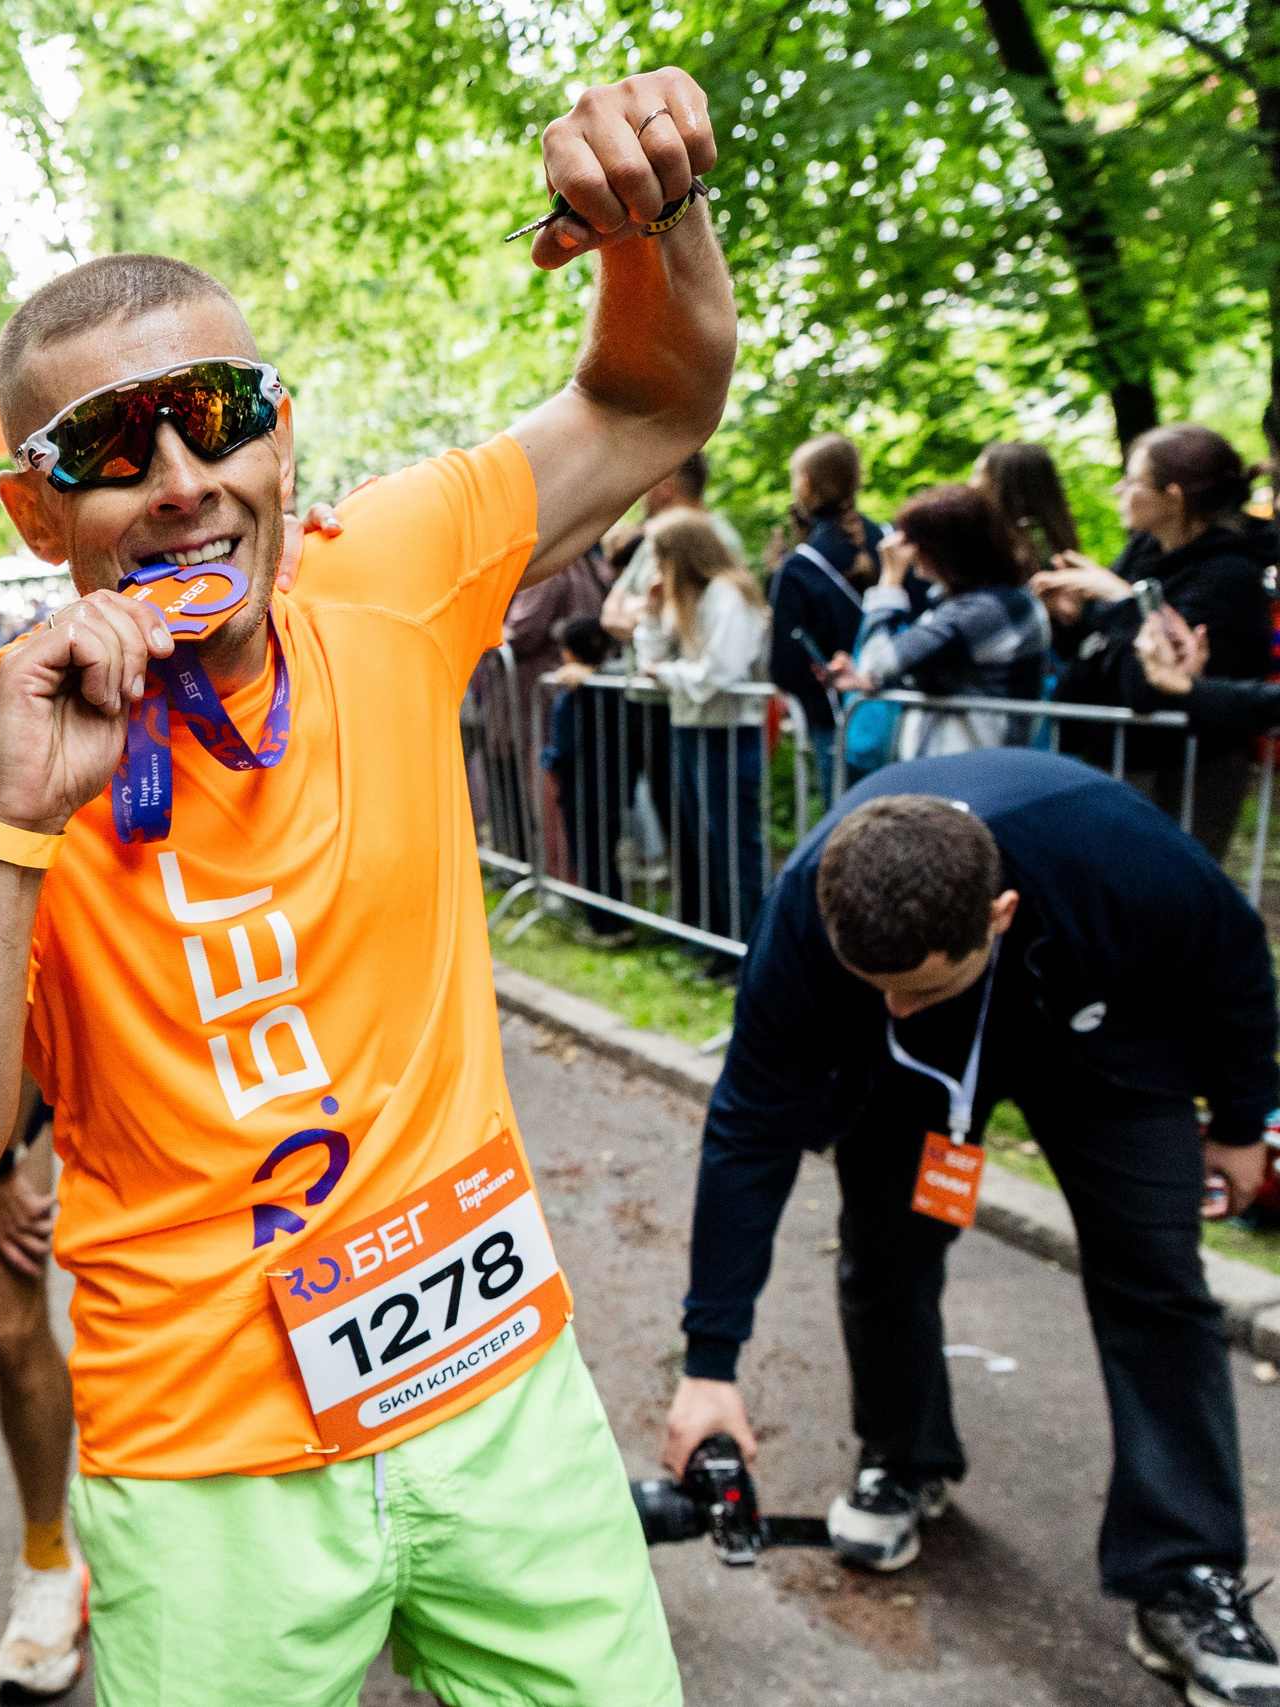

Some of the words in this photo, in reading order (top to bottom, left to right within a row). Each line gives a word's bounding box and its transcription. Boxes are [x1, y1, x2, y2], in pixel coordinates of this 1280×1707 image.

[179, 671, 203, 700] БЕГ
[140, 777, 152, 807] Парк
[151, 753, 163, 806] Горького
[453, 1167, 489, 1198] Парк
[458, 1168, 515, 1213] Горького
[329, 1230, 524, 1377] 1278
[378, 1383, 424, 1414] 5КМ
[426, 1330, 511, 1390] КЛАСТЕР
